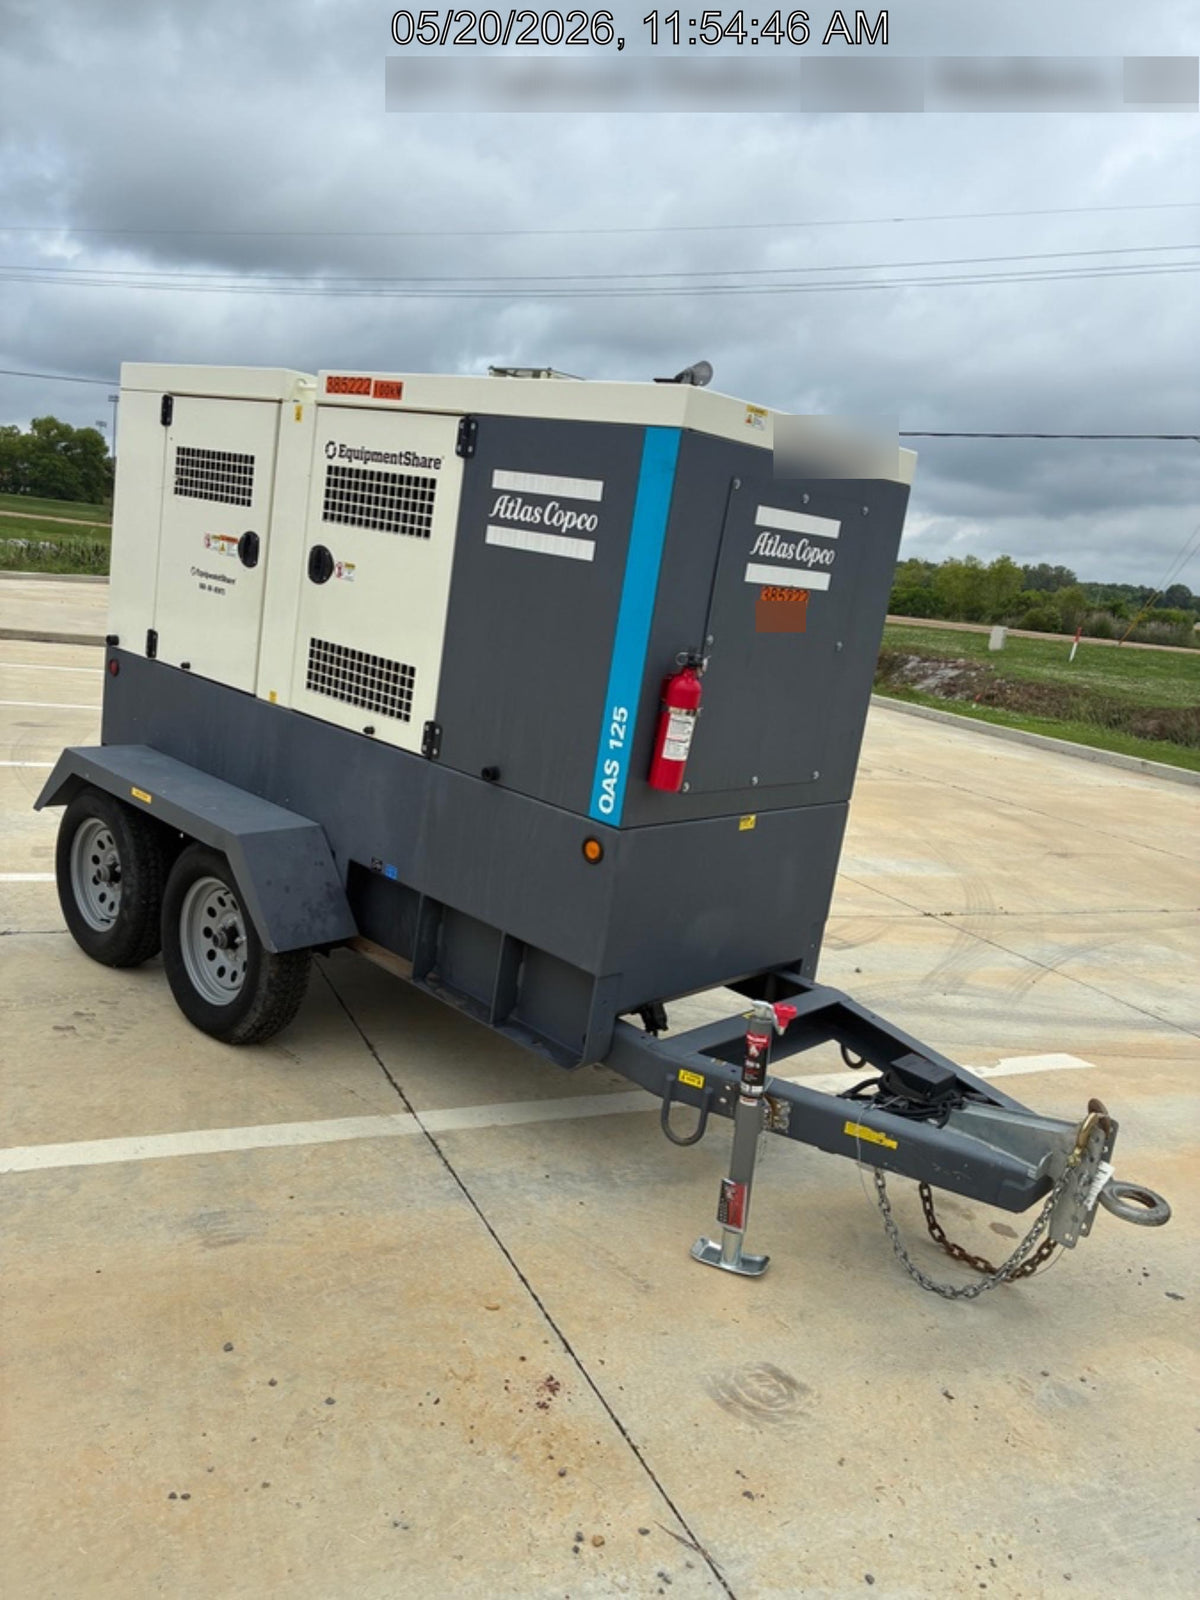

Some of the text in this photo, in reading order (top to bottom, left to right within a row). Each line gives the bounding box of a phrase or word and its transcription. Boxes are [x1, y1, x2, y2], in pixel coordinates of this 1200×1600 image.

[338, 443, 442, 470] EquipmentShare
[488, 494, 599, 534] Atlas Copco
[749, 531, 836, 568] Atlas Copco
[609, 706, 628, 750] 125
